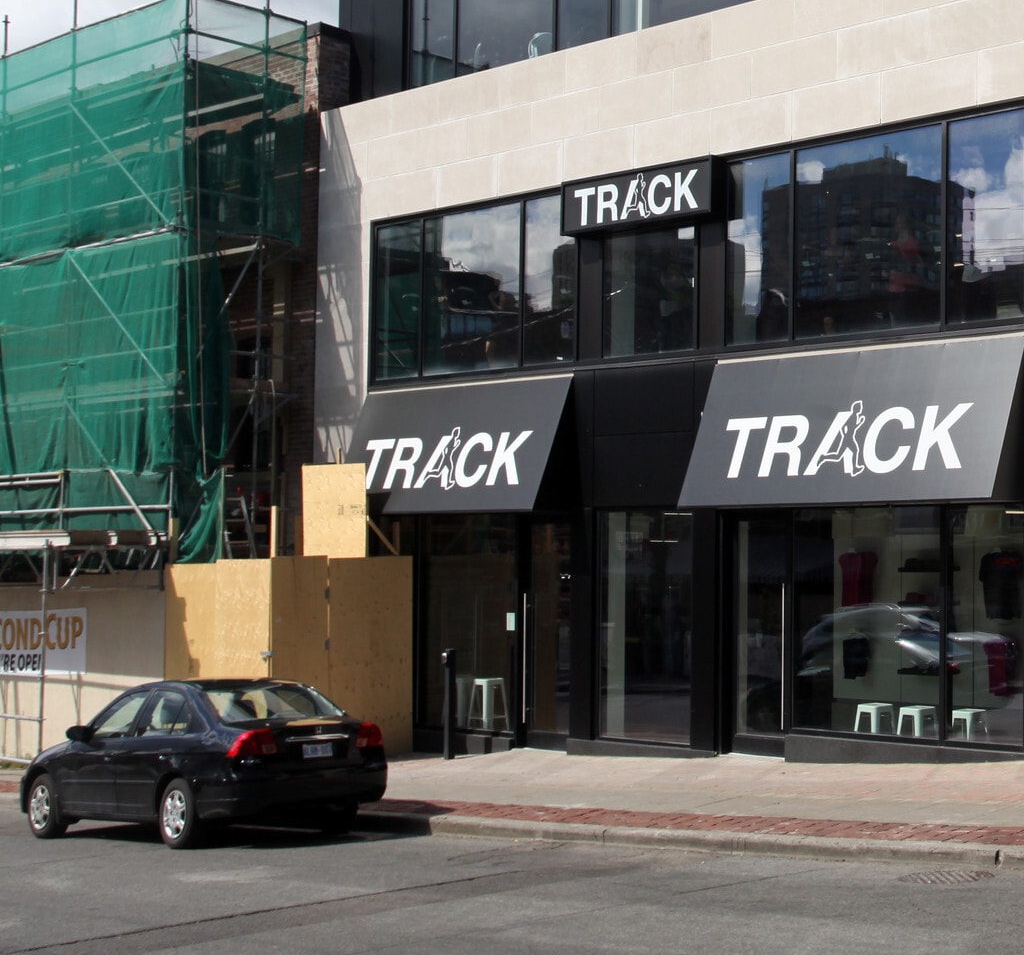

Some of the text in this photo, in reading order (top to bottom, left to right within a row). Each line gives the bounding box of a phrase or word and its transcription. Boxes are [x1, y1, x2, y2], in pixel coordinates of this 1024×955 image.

[574, 169, 699, 226] TRACK
[365, 427, 534, 490] TRACK
[725, 400, 975, 479] TRACK
[0, 613, 84, 651] OND CUP
